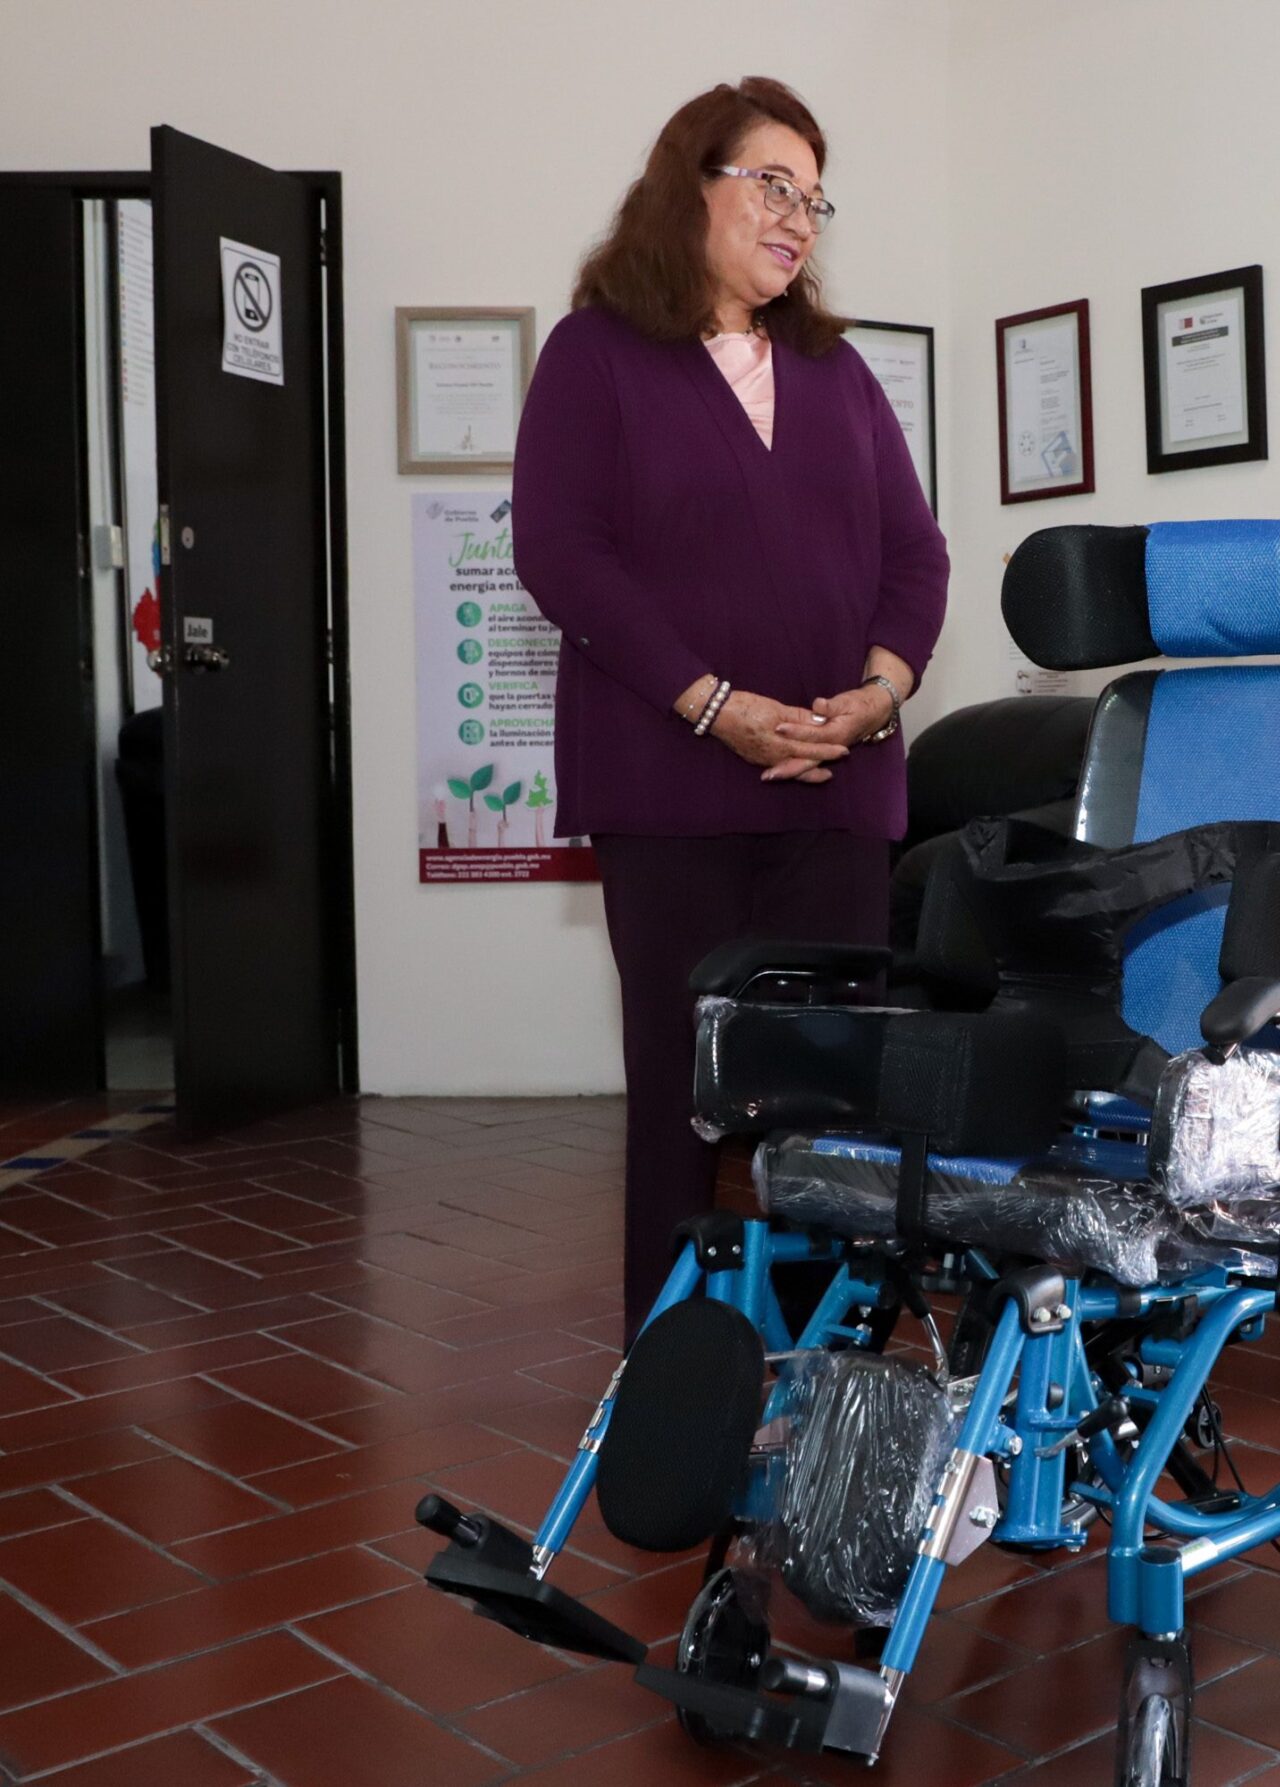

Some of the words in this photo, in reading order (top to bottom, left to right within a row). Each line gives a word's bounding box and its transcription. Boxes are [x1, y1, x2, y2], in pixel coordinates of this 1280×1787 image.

[455, 568, 495, 577] sumar
[450, 581, 497, 594] energía
[499, 582, 514, 592] en
[489, 603, 528, 613] APAGA
[187, 624, 208, 639] Jale
[488, 650, 524, 658] equipos
[488, 659, 554, 667] dispensadores
[489, 681, 539, 690] VERIFICA
[489, 694, 506, 702] que
[516, 693, 551, 702] puertas
[489, 703, 517, 712] hayan
[499, 729, 551, 737] iluminación
